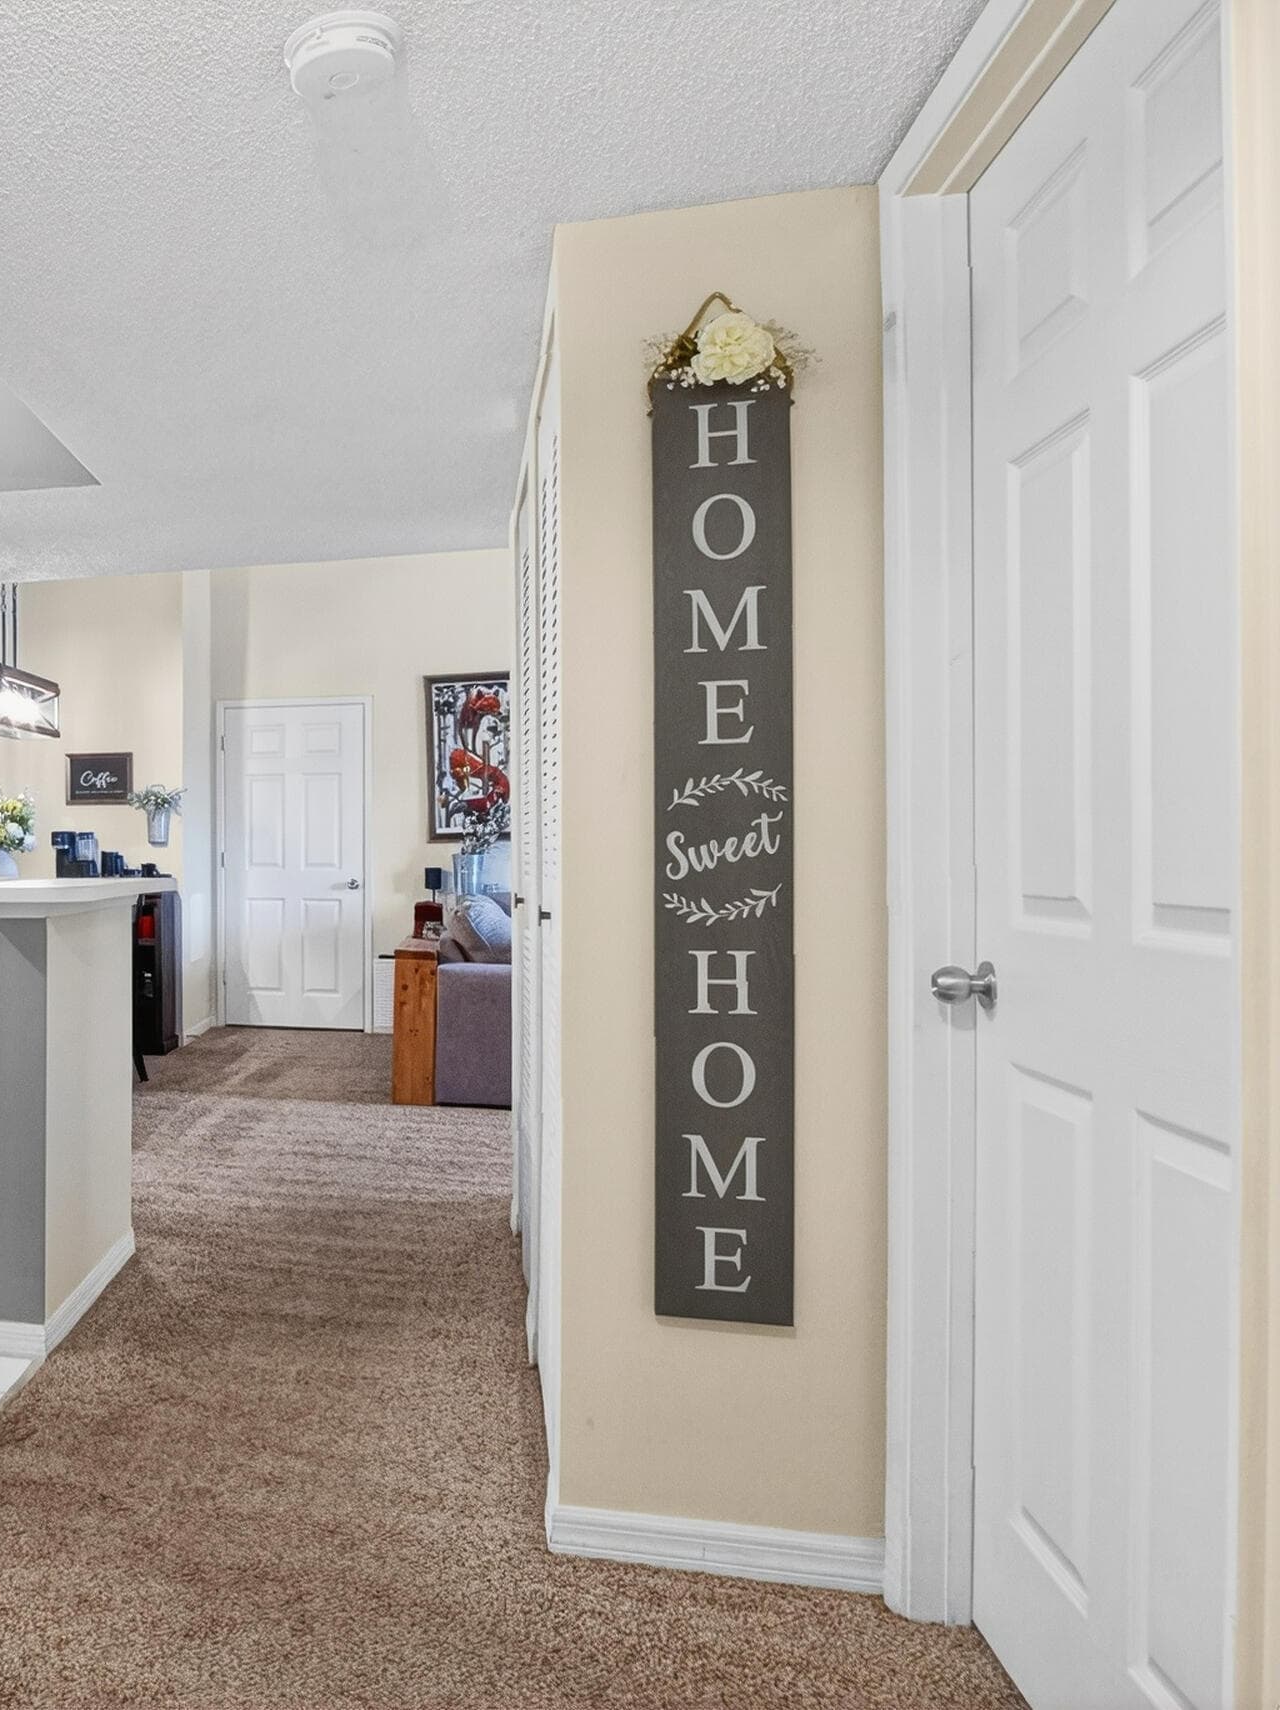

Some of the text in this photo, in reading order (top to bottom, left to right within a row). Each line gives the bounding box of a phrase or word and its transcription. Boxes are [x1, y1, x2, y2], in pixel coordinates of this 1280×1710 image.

[682, 400, 768, 745] HOME
[80, 770, 118, 788] Coffee
[665, 810, 784, 881] Sweet
[681, 950, 767, 1293] HOME
